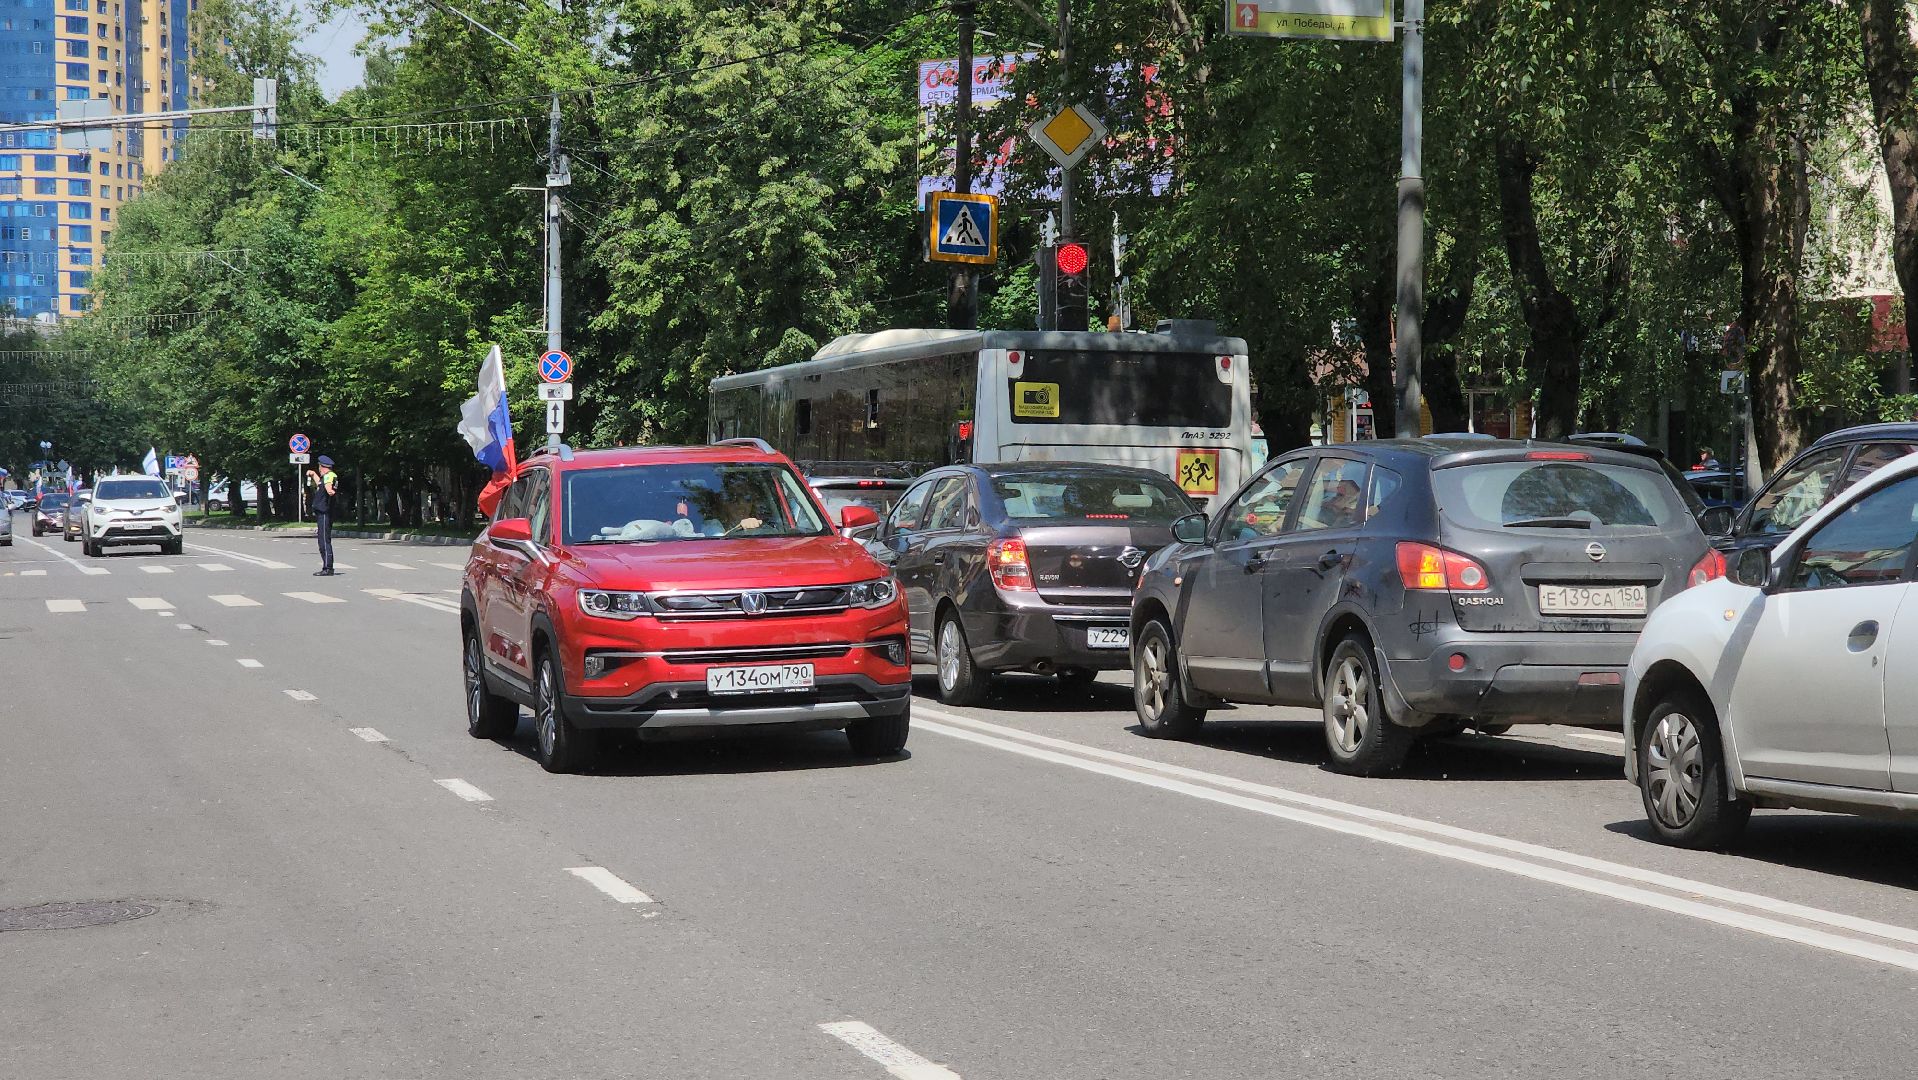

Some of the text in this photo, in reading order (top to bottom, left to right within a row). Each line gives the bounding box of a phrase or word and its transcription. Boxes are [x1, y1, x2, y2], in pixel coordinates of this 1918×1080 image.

[1294, 18, 1334, 30] Победы,
[1350, 20, 1357, 29] 7
[1208, 432, 1231, 440] 5292
[168, 457, 177, 468] P
[1617, 588, 1642, 602] 150
[1458, 596, 1504, 606] QASHQAI
[783, 665, 809, 680] 790
